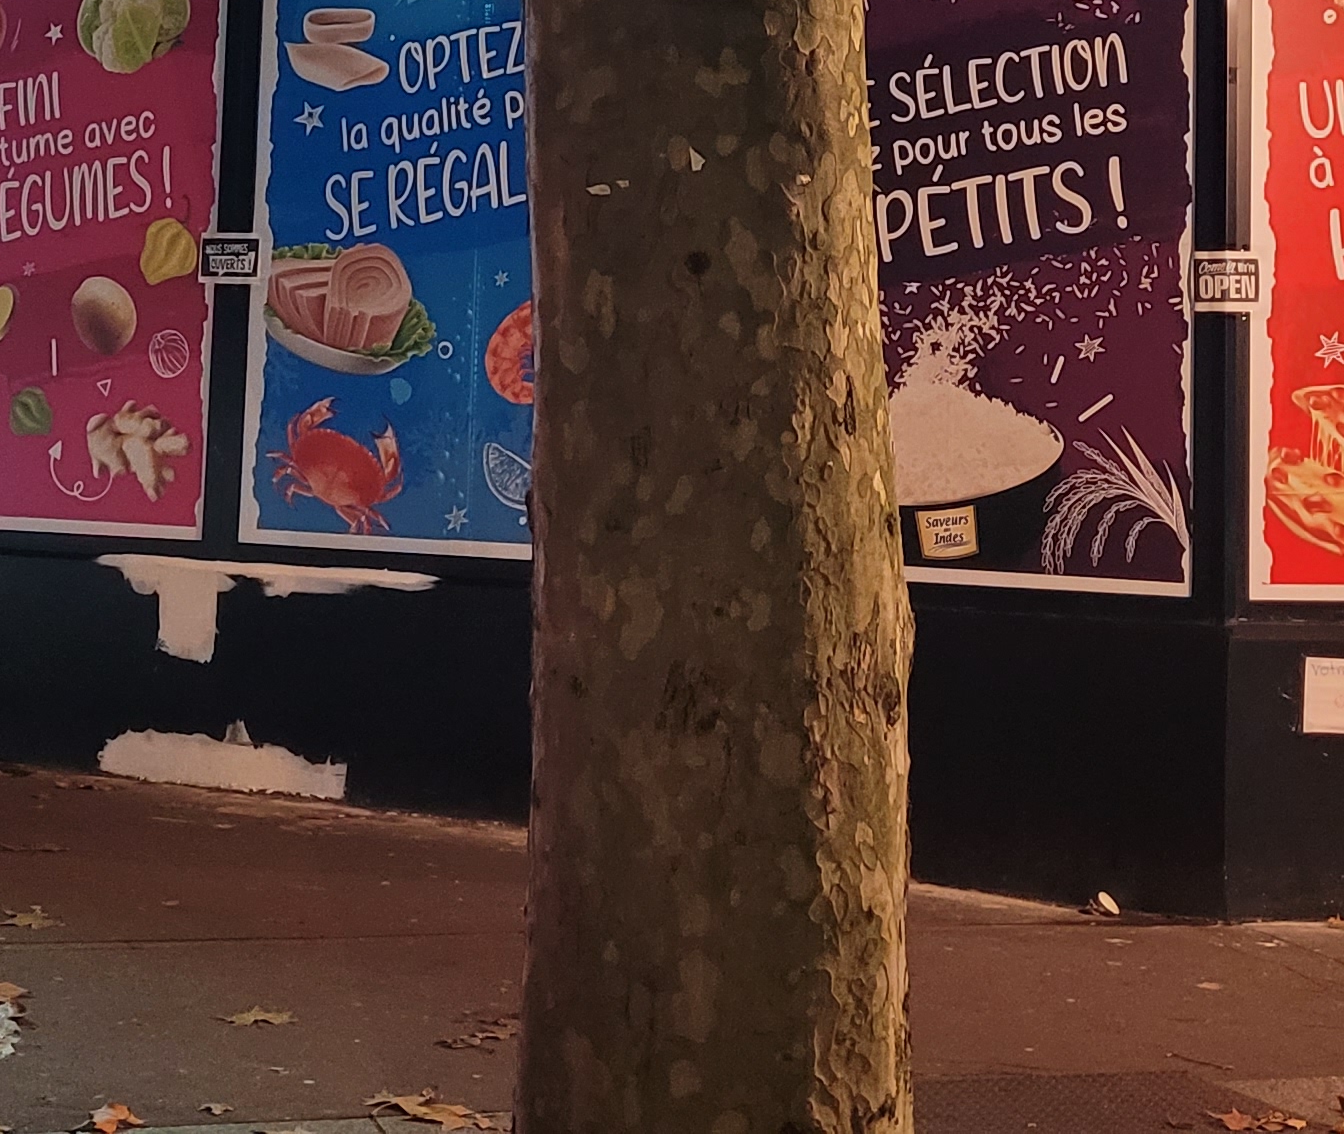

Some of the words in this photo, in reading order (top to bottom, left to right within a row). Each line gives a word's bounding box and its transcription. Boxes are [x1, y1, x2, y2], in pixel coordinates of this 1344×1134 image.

[398, 21, 526, 94] OPTEZ
[889, 32, 1129, 123] SÉLECTION
[84, 110, 156, 149] avec
[341, 116, 368, 153] la
[380, 88, 492, 154] qualité
[892, 128, 970, 176] pour
[982, 112, 1063, 152] tous
[1073, 102, 1128, 138] les
[325, 170, 377, 241] SE
[387, 141, 527, 230] RÉGAL
[1308, 146, 1335, 189] à
[875, 160, 1094, 263] PÉTITS
[210, 258, 246, 271] OUVERTS
[1199, 275, 1256, 299] OPEN
[925, 514, 969, 530] Saveurs
[933, 532, 964, 546] Indes
